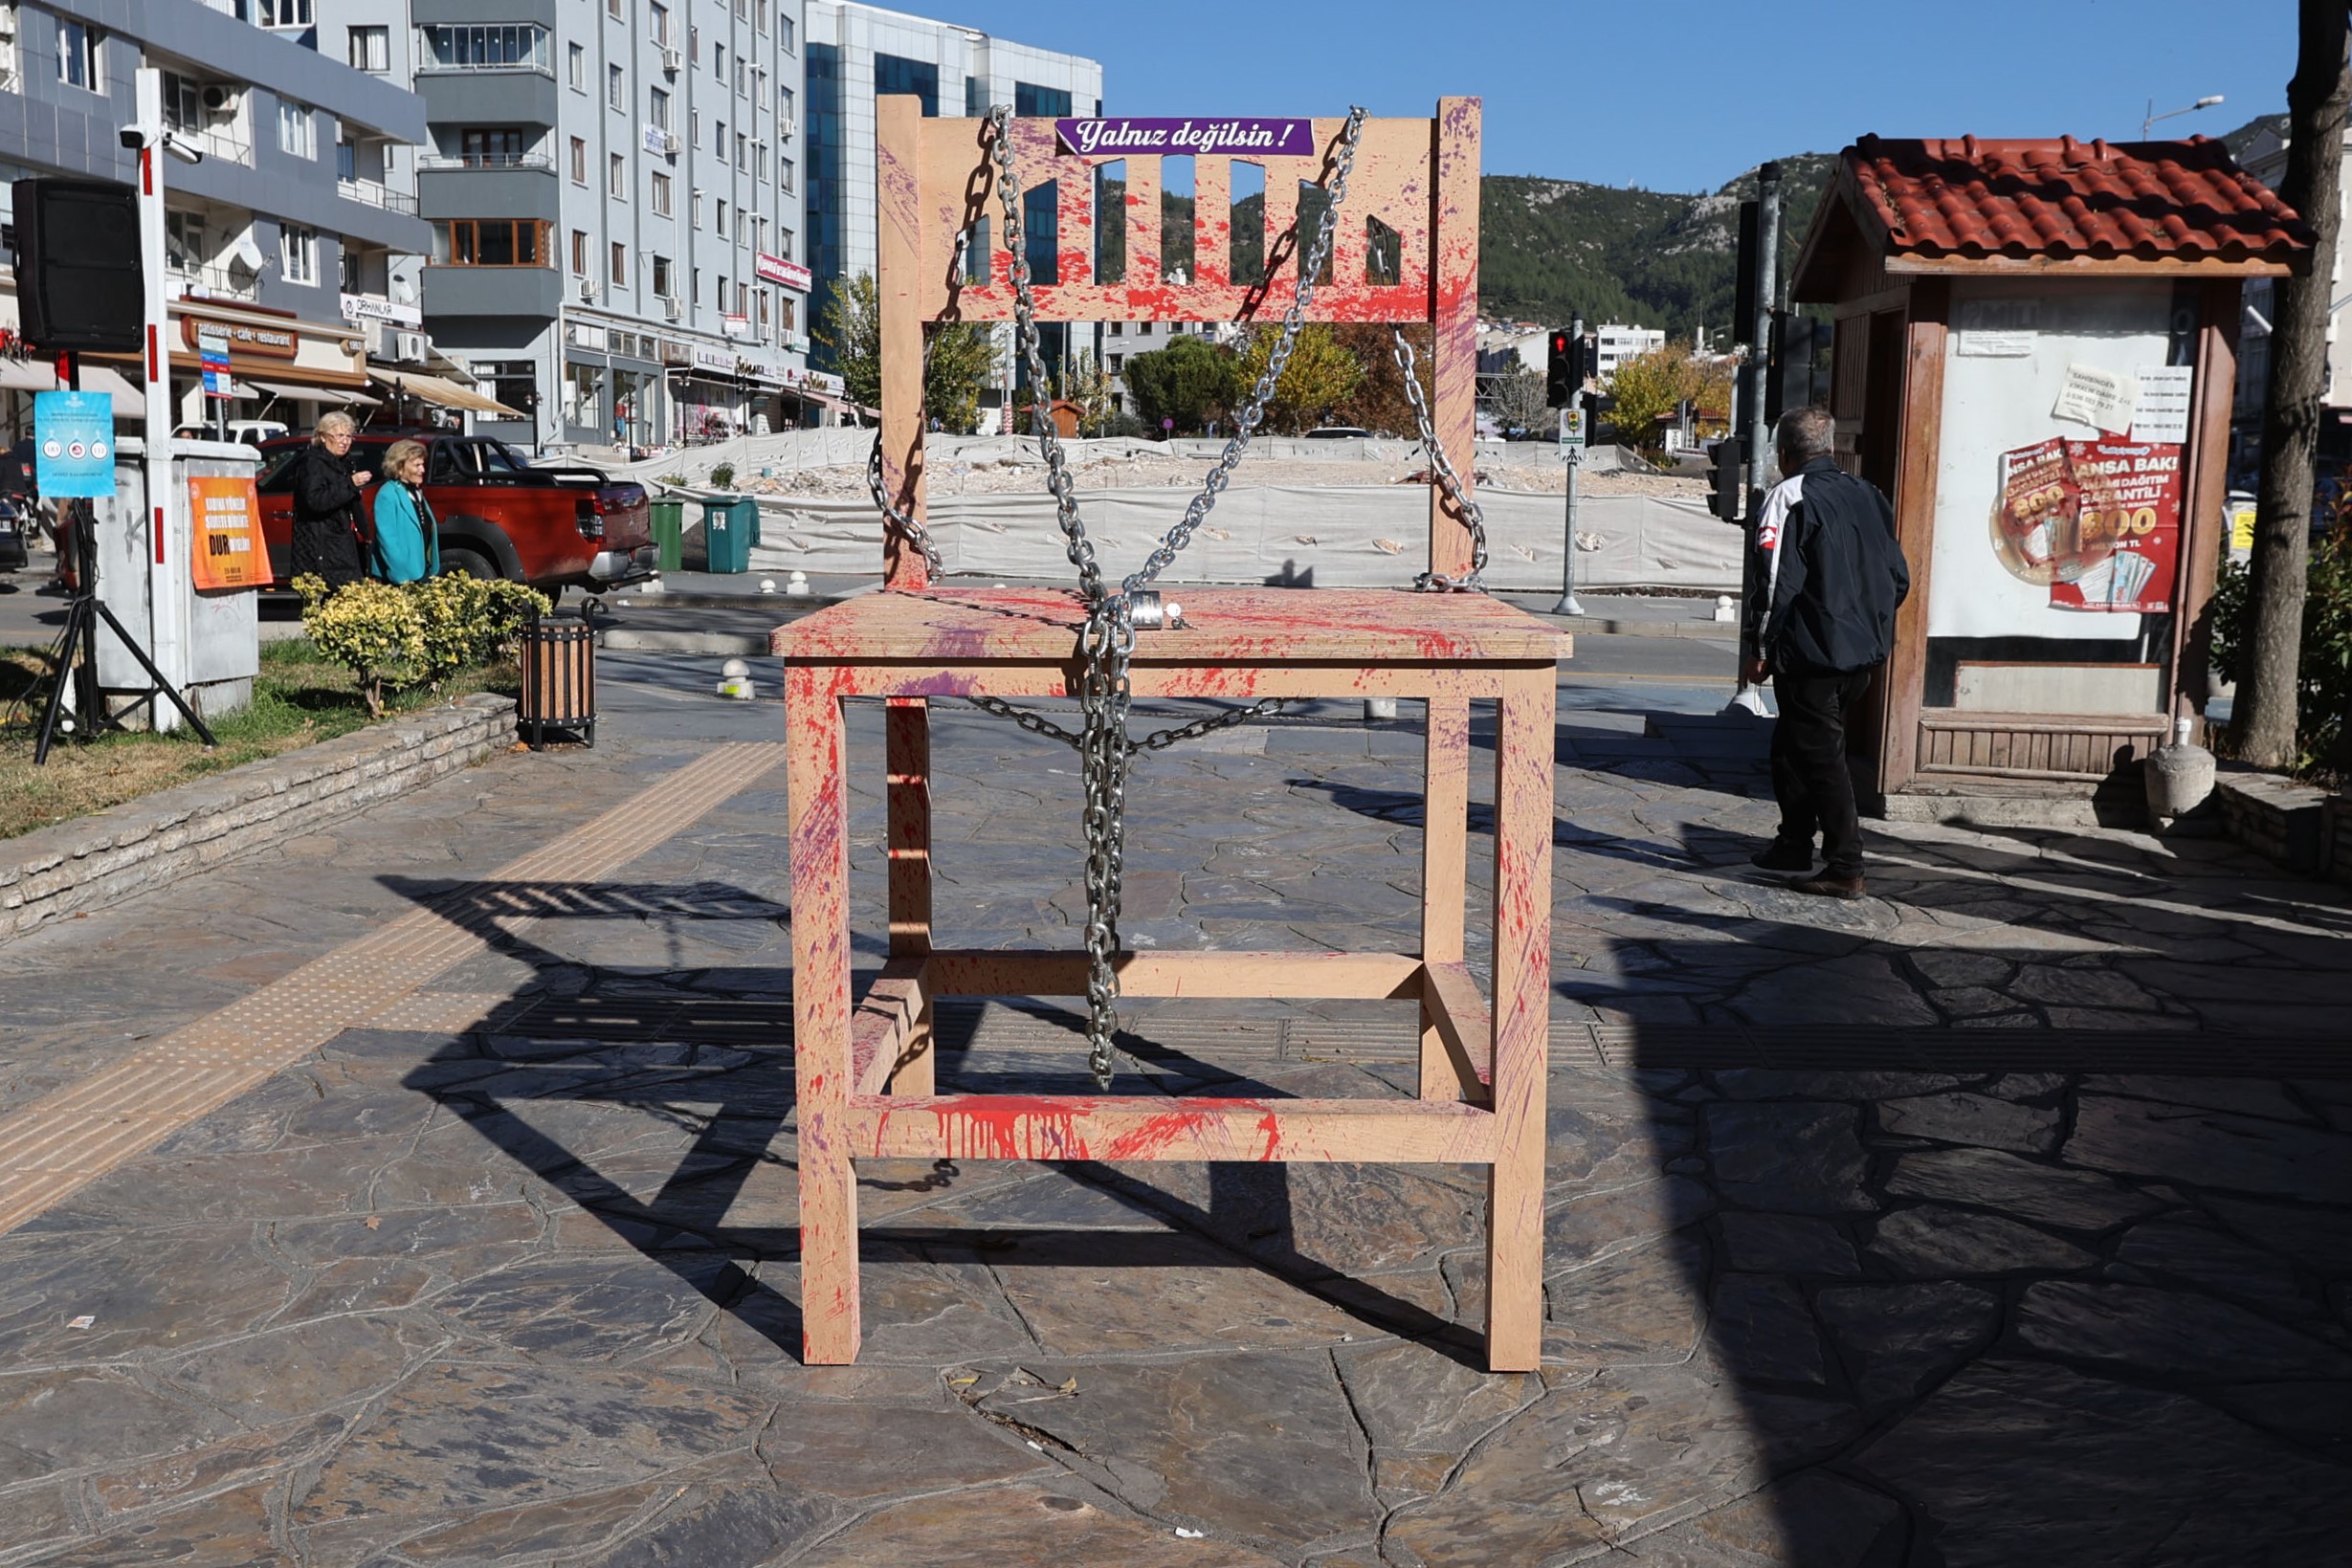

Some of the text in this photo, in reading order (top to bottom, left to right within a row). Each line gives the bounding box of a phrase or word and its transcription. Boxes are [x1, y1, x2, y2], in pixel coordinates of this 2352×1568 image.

[1076, 121, 1167, 153] Yalnız
[1171, 121, 1274, 153] değilsin
[197, 322, 233, 338] patisserie
[256, 332, 291, 346] restaurant
[2073, 459, 2131, 478] ANSA
[2134, 456, 2179, 472] BAK!
[2121, 475, 2169, 488] DAĞITIM
[209, 535, 231, 556] DUR
[2129, 539, 2141, 547] TL
